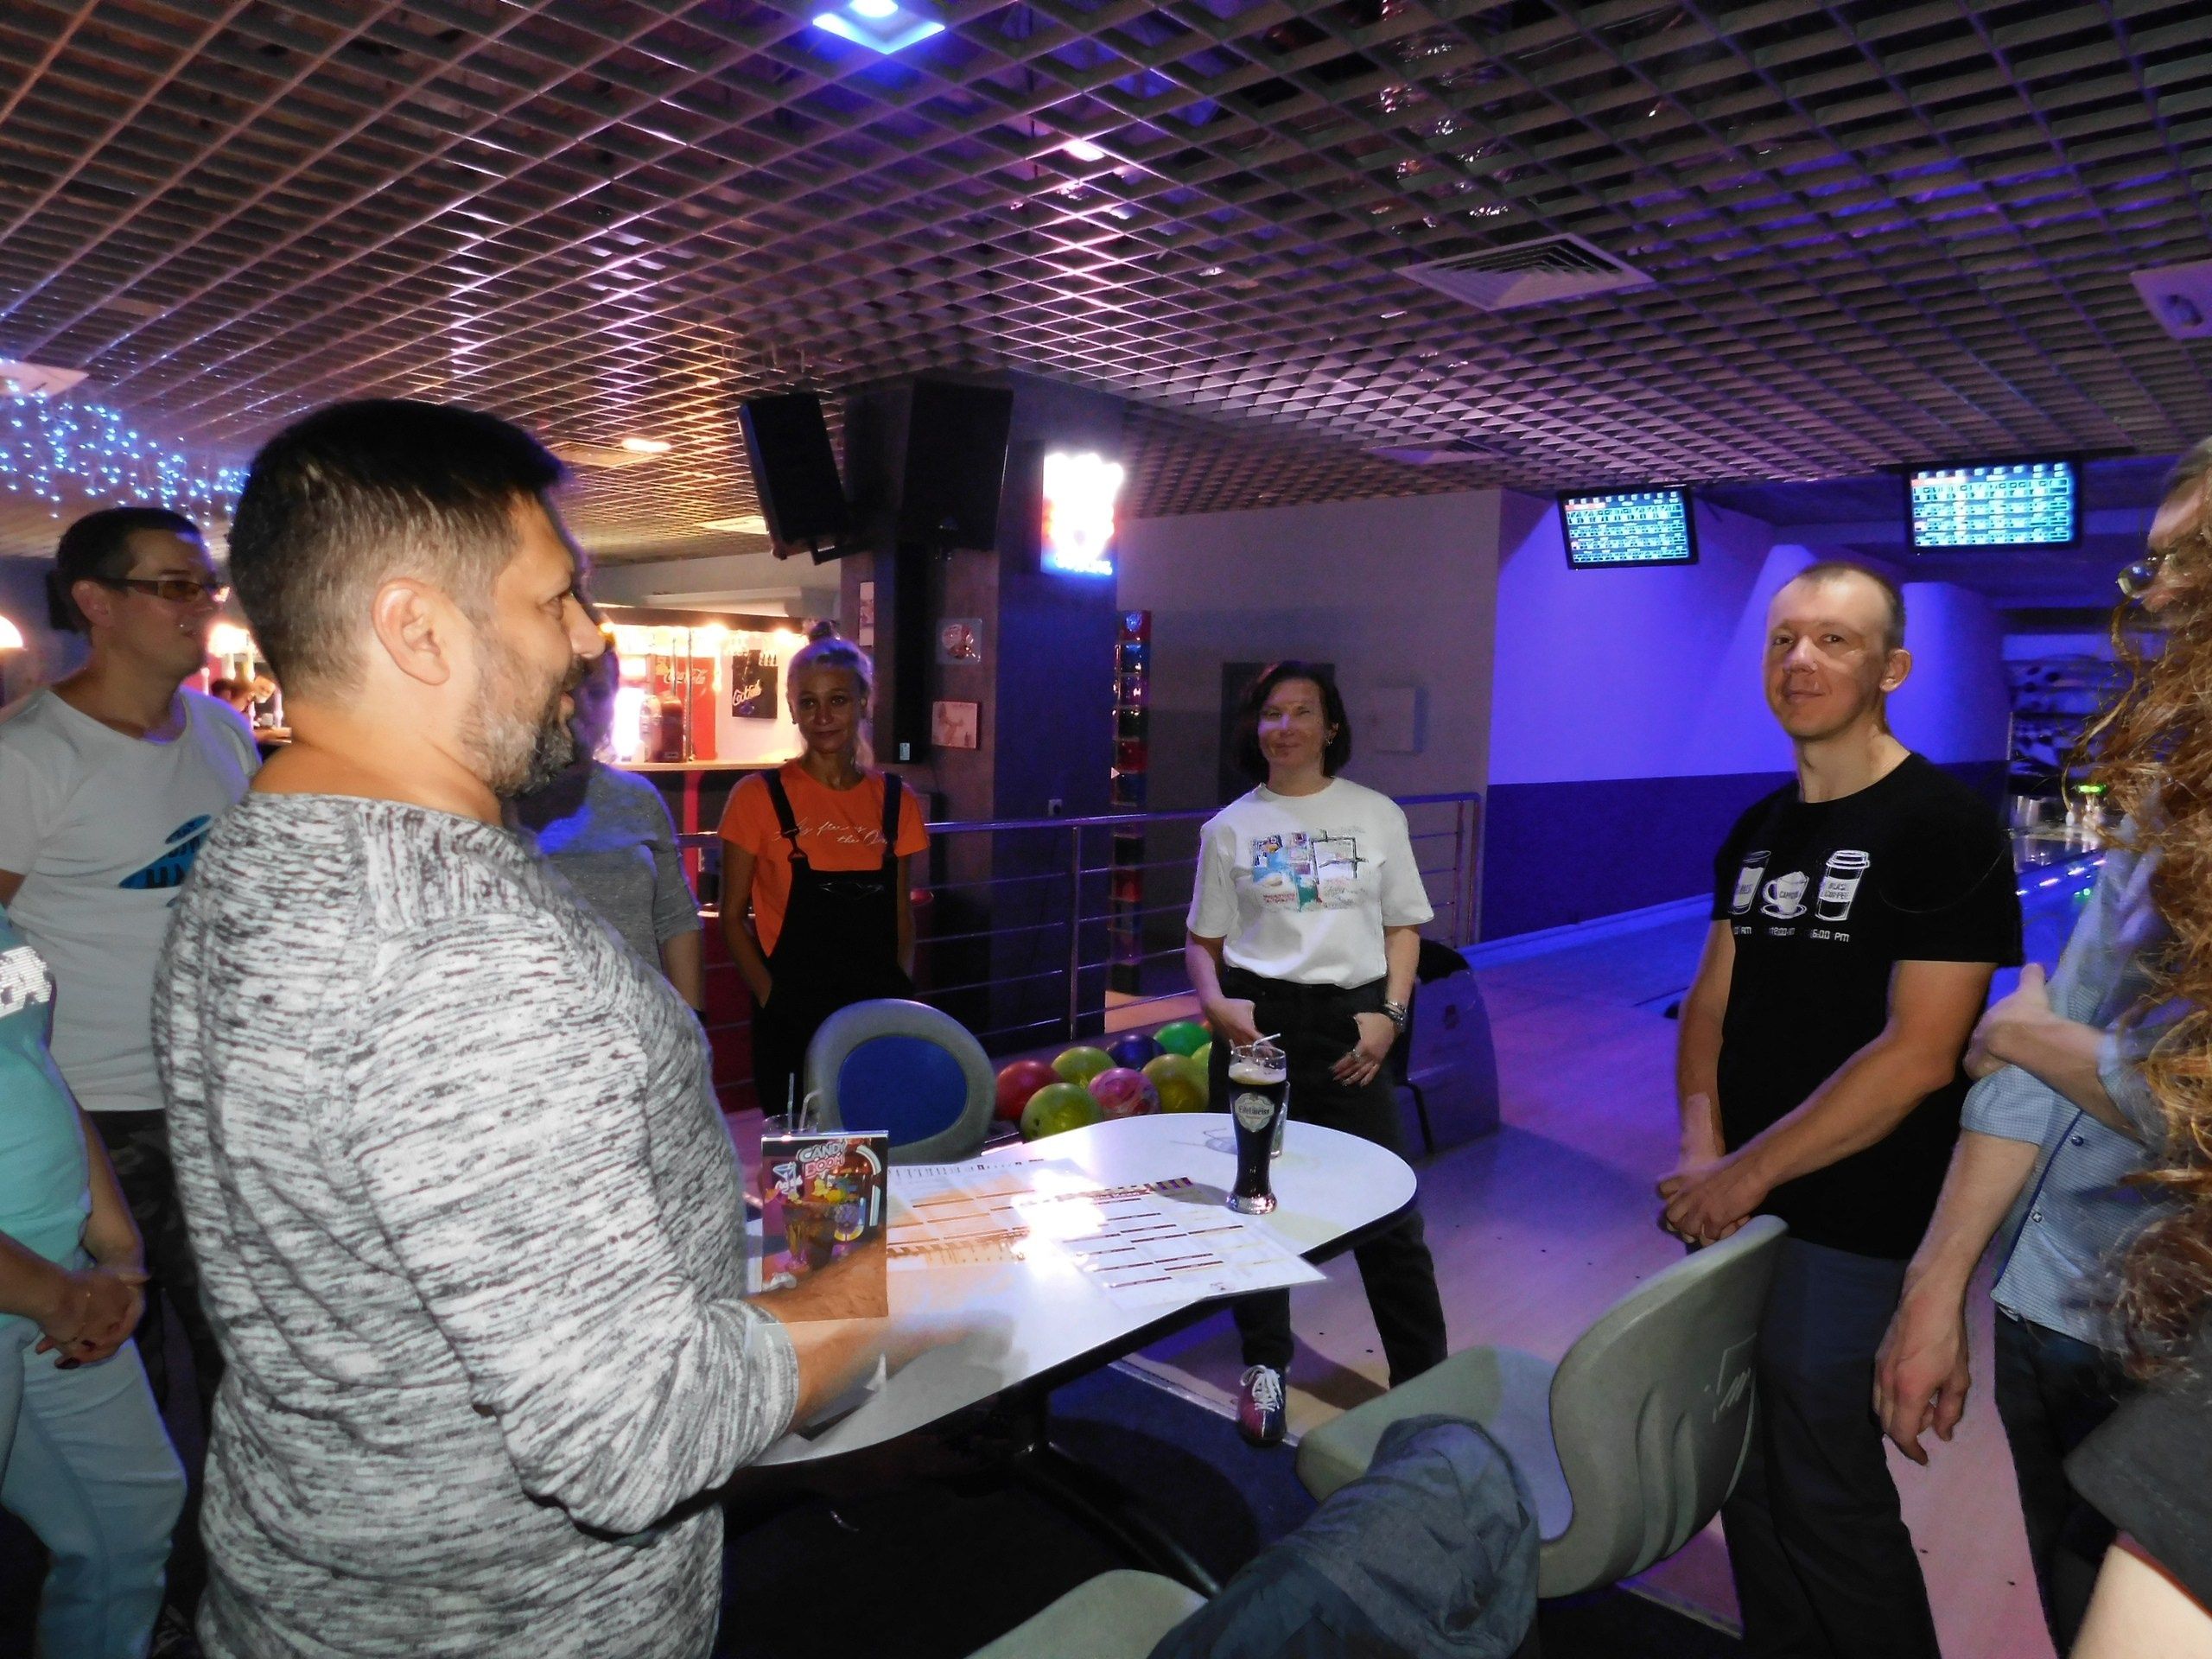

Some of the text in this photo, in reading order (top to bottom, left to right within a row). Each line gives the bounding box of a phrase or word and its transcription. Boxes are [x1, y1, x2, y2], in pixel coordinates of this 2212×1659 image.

[664, 668, 708, 685] Ccaola
[1834, 931, 1850, 943] PM
[797, 1140, 847, 1163] CANDY
[803, 1154, 845, 1179] BOOM
